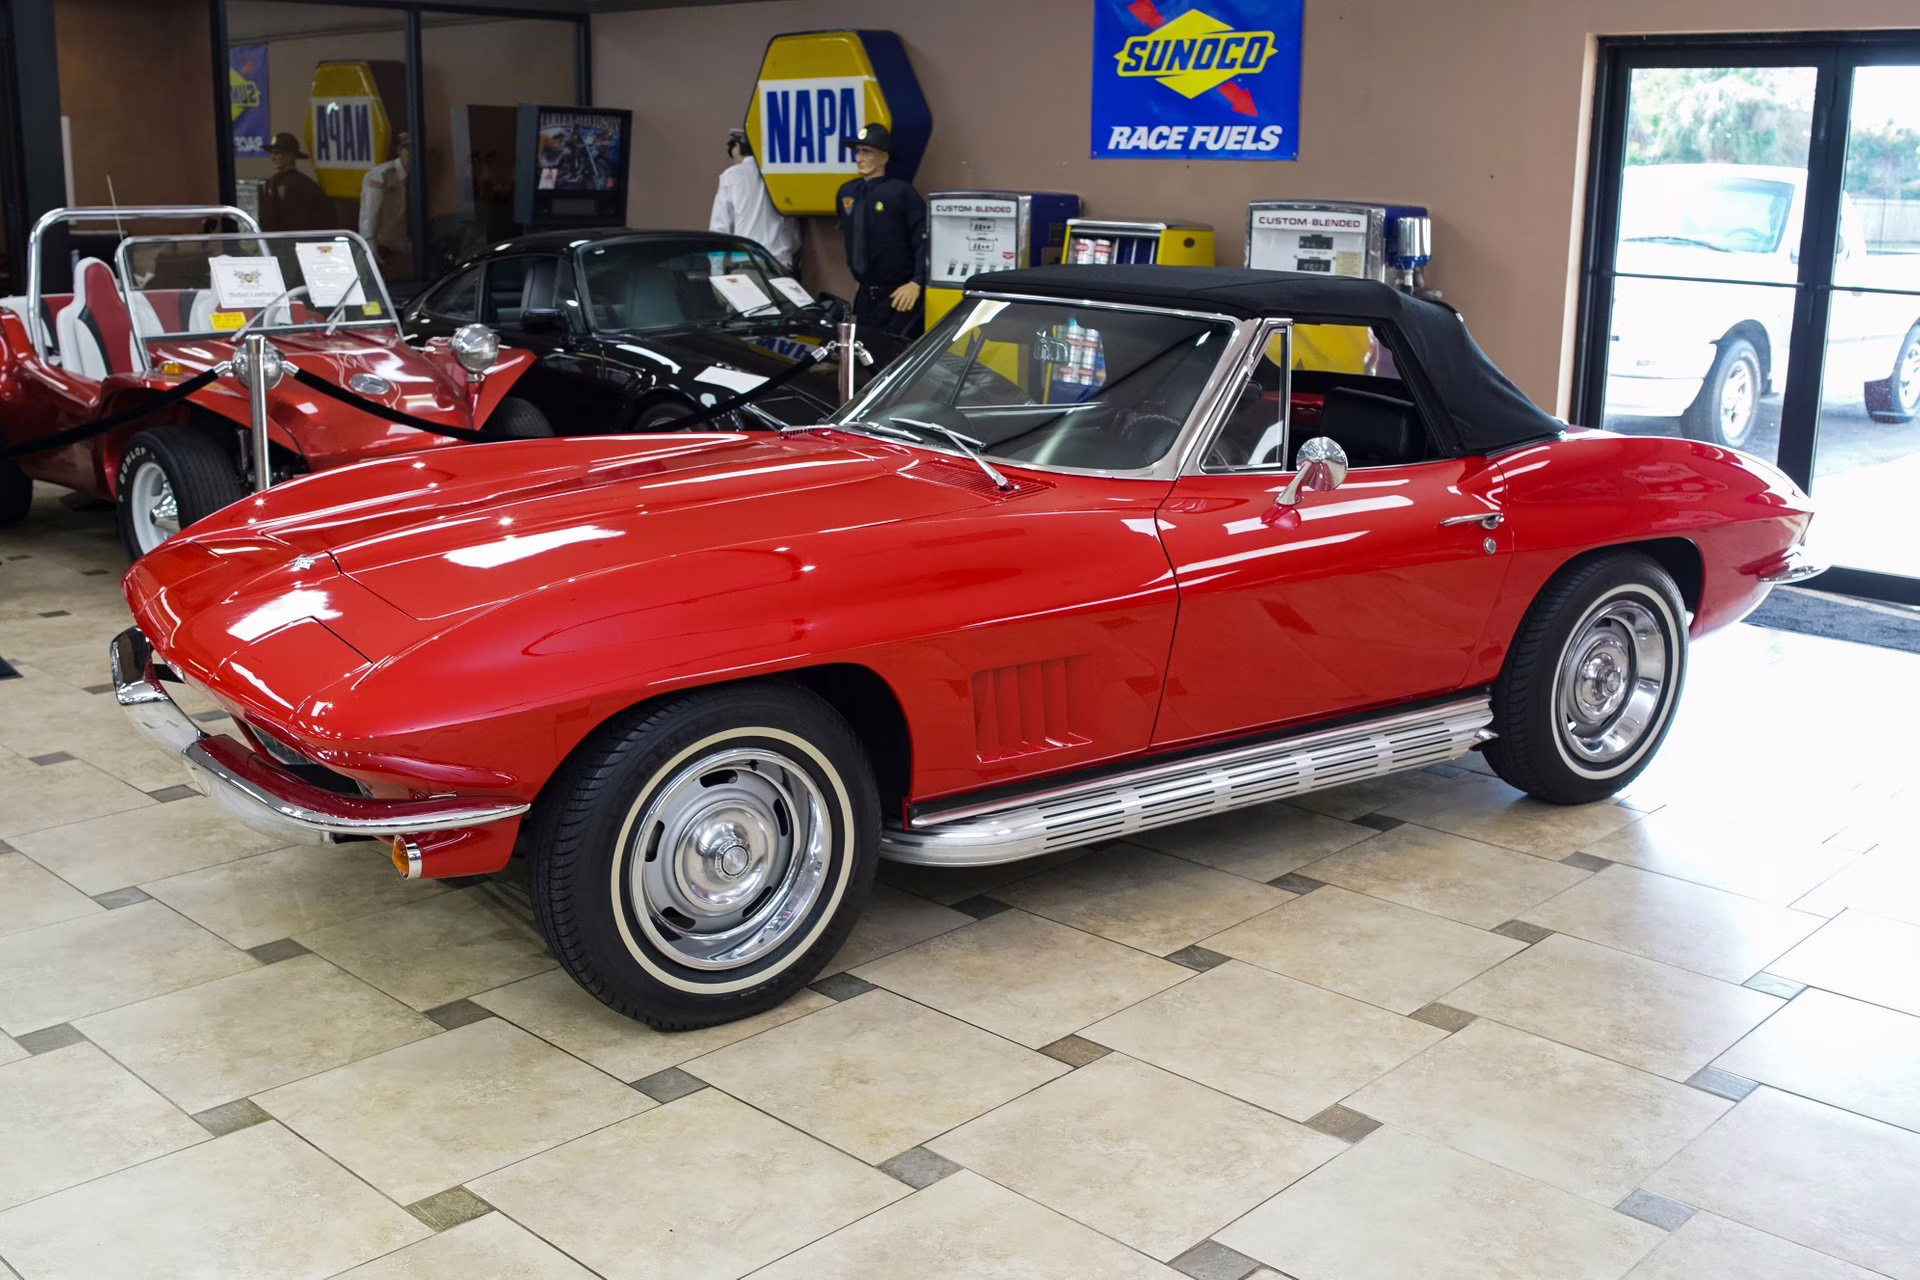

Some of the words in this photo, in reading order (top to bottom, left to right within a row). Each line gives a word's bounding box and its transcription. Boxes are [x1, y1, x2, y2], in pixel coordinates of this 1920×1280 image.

[1122, 36, 1270, 72] SUNOCO
[766, 88, 858, 164] NAPA
[1107, 126, 1188, 150] RACE
[1188, 125, 1283, 151] FUELS
[119, 447, 146, 485] DUNLOP
